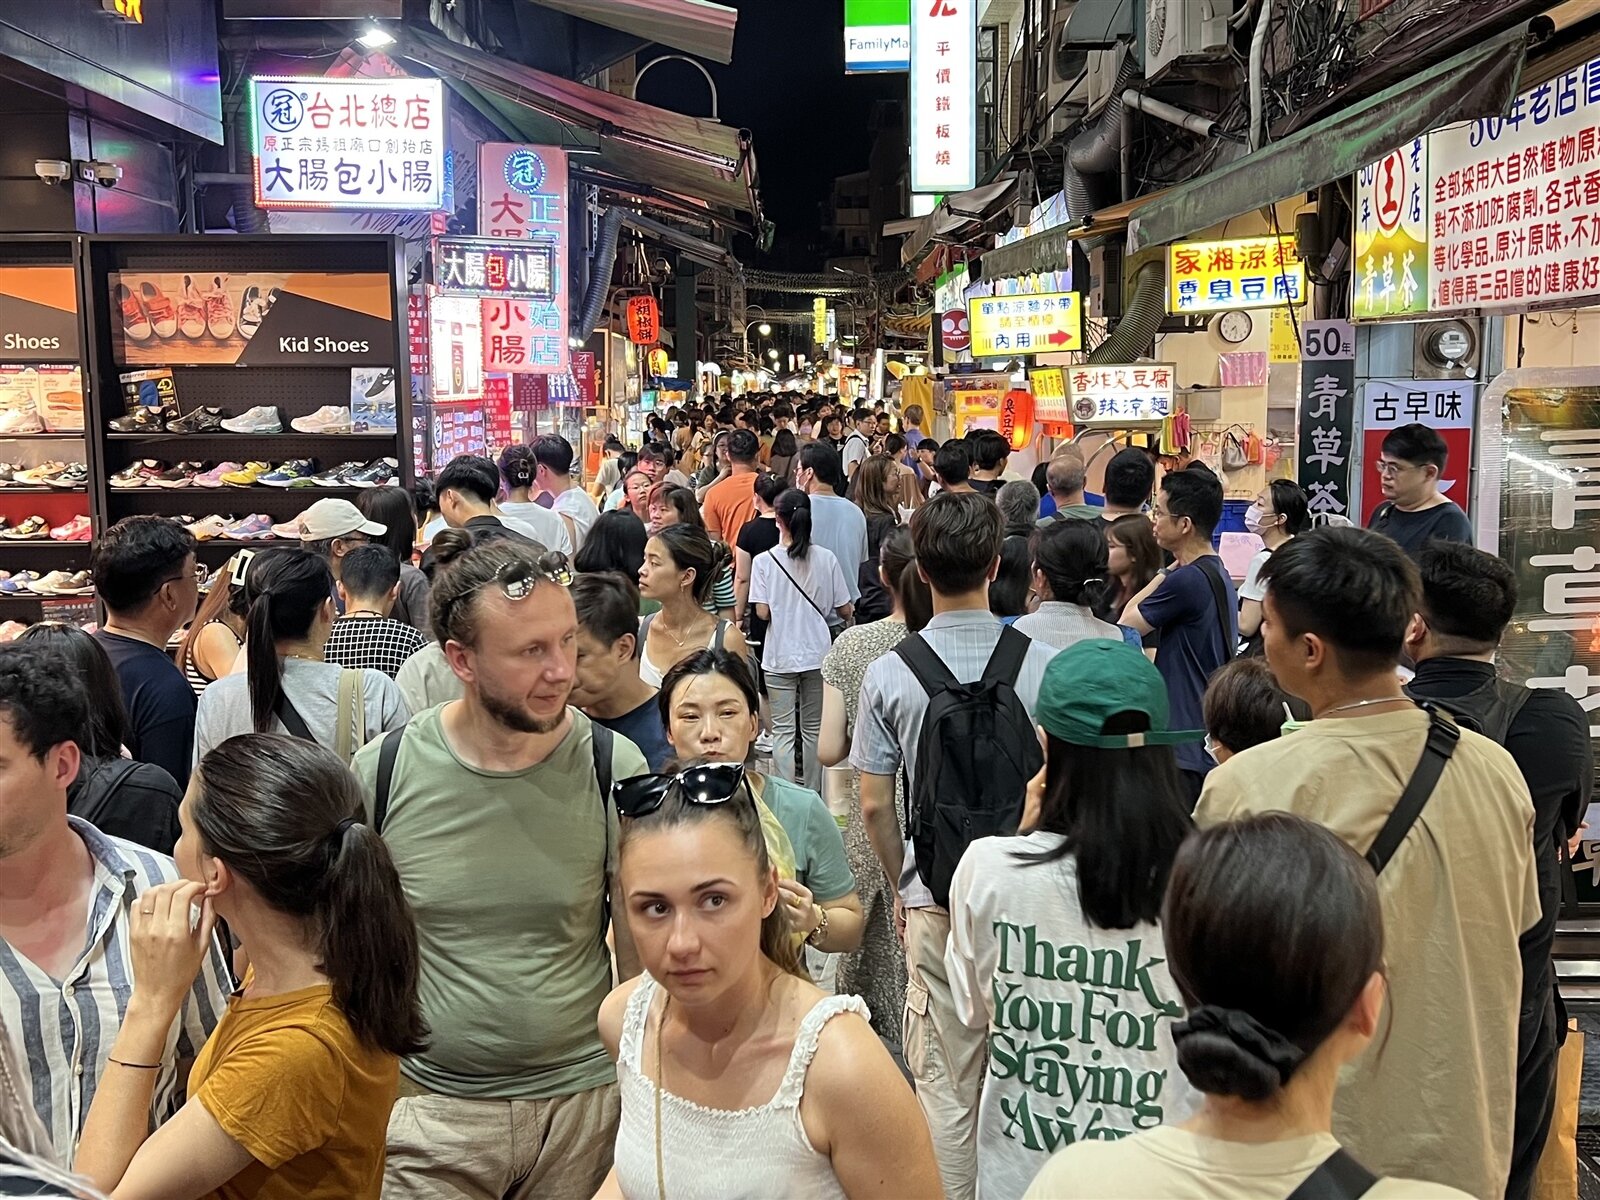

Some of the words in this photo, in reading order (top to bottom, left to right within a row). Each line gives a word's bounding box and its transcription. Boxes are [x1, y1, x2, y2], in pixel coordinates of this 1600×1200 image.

[849, 37, 909, 52] FamilyMa
[269, 92, 299, 127] 冠
[307, 92, 431, 129] 台北總店
[935, 41, 951, 165] 平價鐵板燒
[265, 157, 432, 195] 大腸包小腸
[1434, 126, 1600, 204] 全部採用大自然植物原
[443, 252, 549, 289] 大腸包小腸
[1361, 249, 1418, 313] 青草茶
[1208, 275, 1299, 304] 臭豆腐
[4, 333, 61, 351] Shoes
[278, 336, 310, 354] Kid
[314, 336, 370, 354] Shoes
[995, 332, 1031, 349] 內用
[1306, 327, 1351, 357] 50年
[1073, 368, 1171, 392] 香炸臭豆腐
[1098, 396, 1169, 417] 辣涼麵
[1373, 390, 1462, 421] 古早味
[1306, 374, 1348, 526] 青草茶
[992, 921, 1185, 1018] Thank
[992, 974, 1076, 1041] You
[1078, 987, 1164, 1051] For
[989, 1032, 1168, 1129] Staying
[1000, 1091, 1138, 1154] Aw
